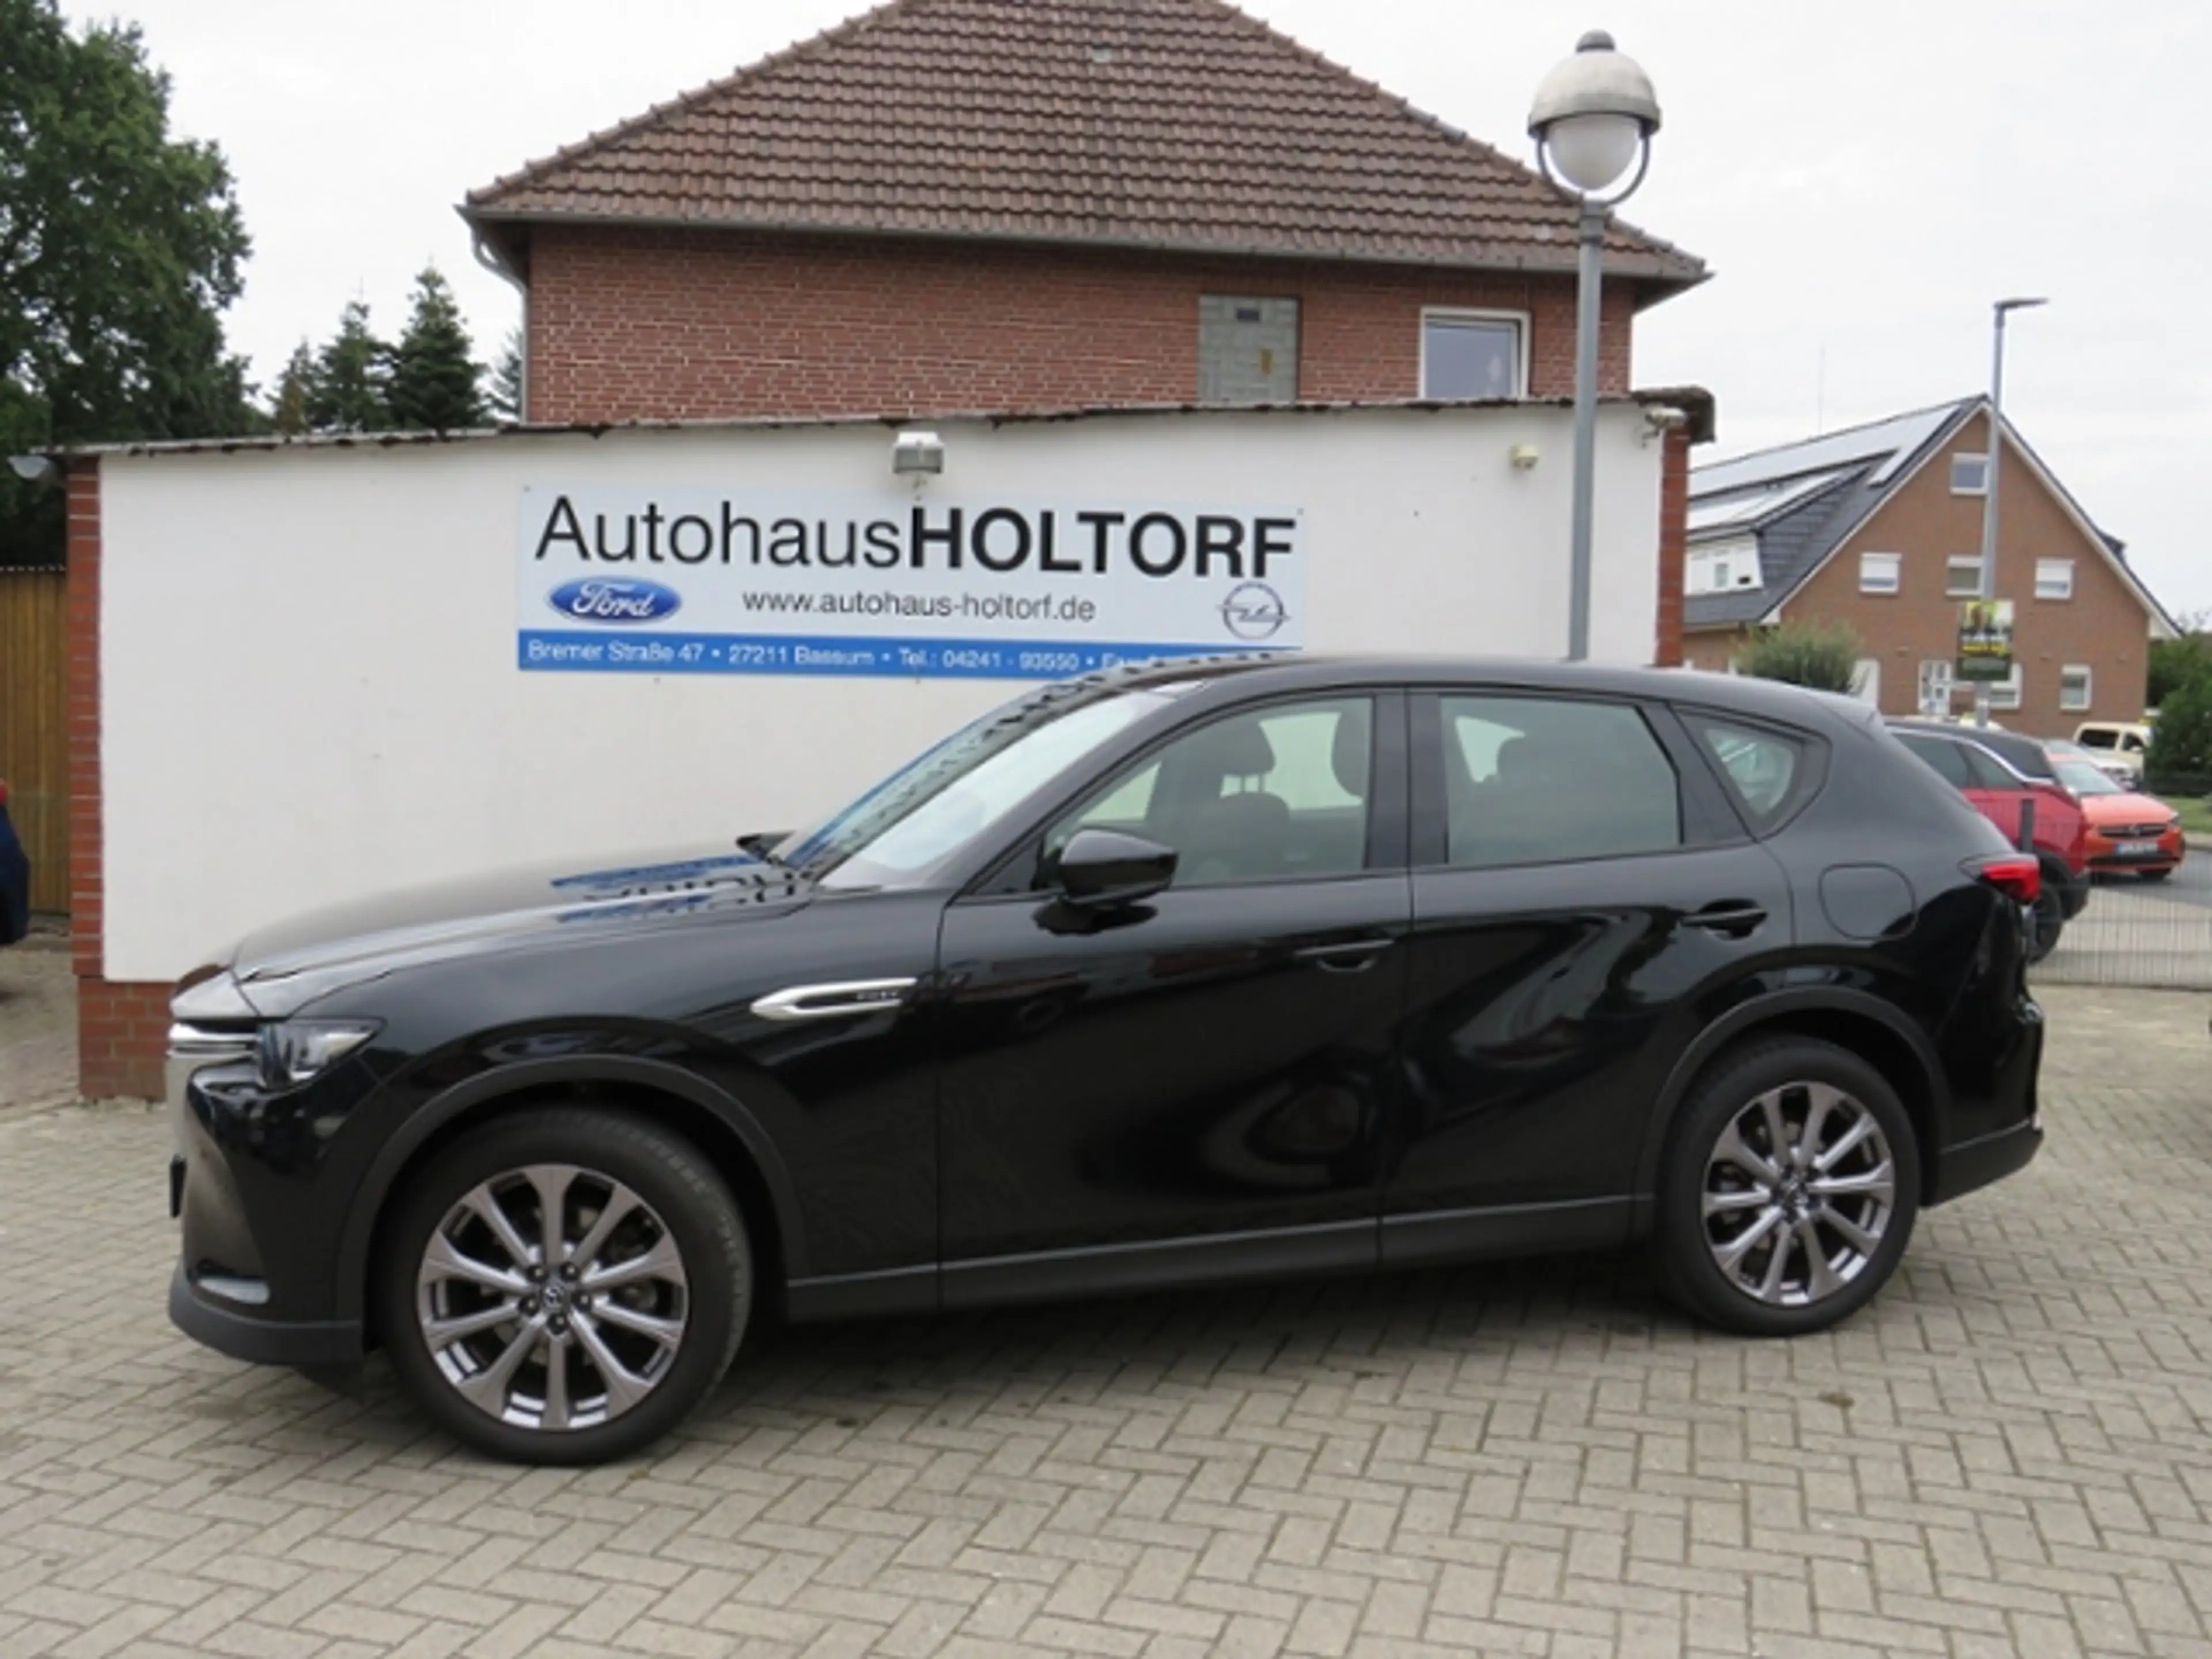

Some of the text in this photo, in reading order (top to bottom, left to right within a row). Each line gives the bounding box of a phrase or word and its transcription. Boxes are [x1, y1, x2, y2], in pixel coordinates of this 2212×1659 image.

[572, 581, 656, 617] Ford
[743, 590, 1095, 622] www.autohaus-holtorf.de
[528, 639, 603, 661] Bremer
[608, 639, 675, 662] Straße
[677, 642, 705, 662] 47
[729, 643, 788, 665] 27211
[794, 645, 875, 666] Bassum
[942, 649, 1001, 668] 04241
